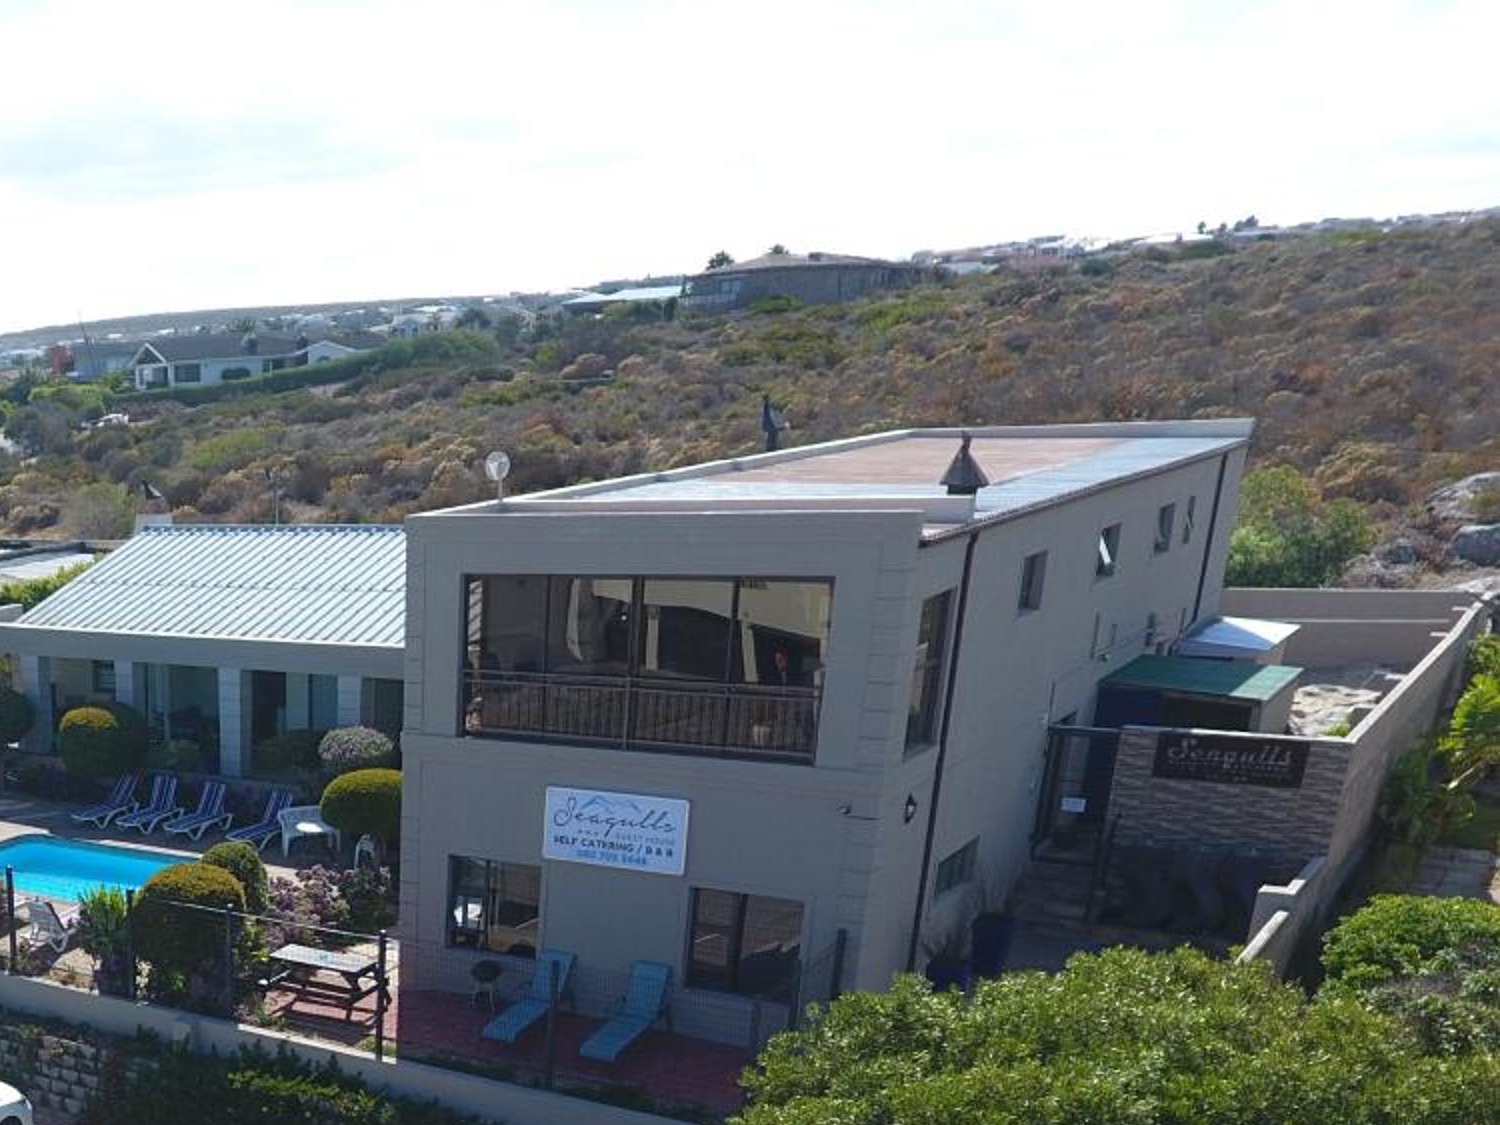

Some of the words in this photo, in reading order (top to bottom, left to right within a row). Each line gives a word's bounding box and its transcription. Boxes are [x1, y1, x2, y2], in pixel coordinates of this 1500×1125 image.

[1168, 738, 1291, 766] Seagulls
[554, 797, 676, 837] Seagulls
[553, 835, 578, 846] SELF
[581, 837, 634, 853] CATERING
